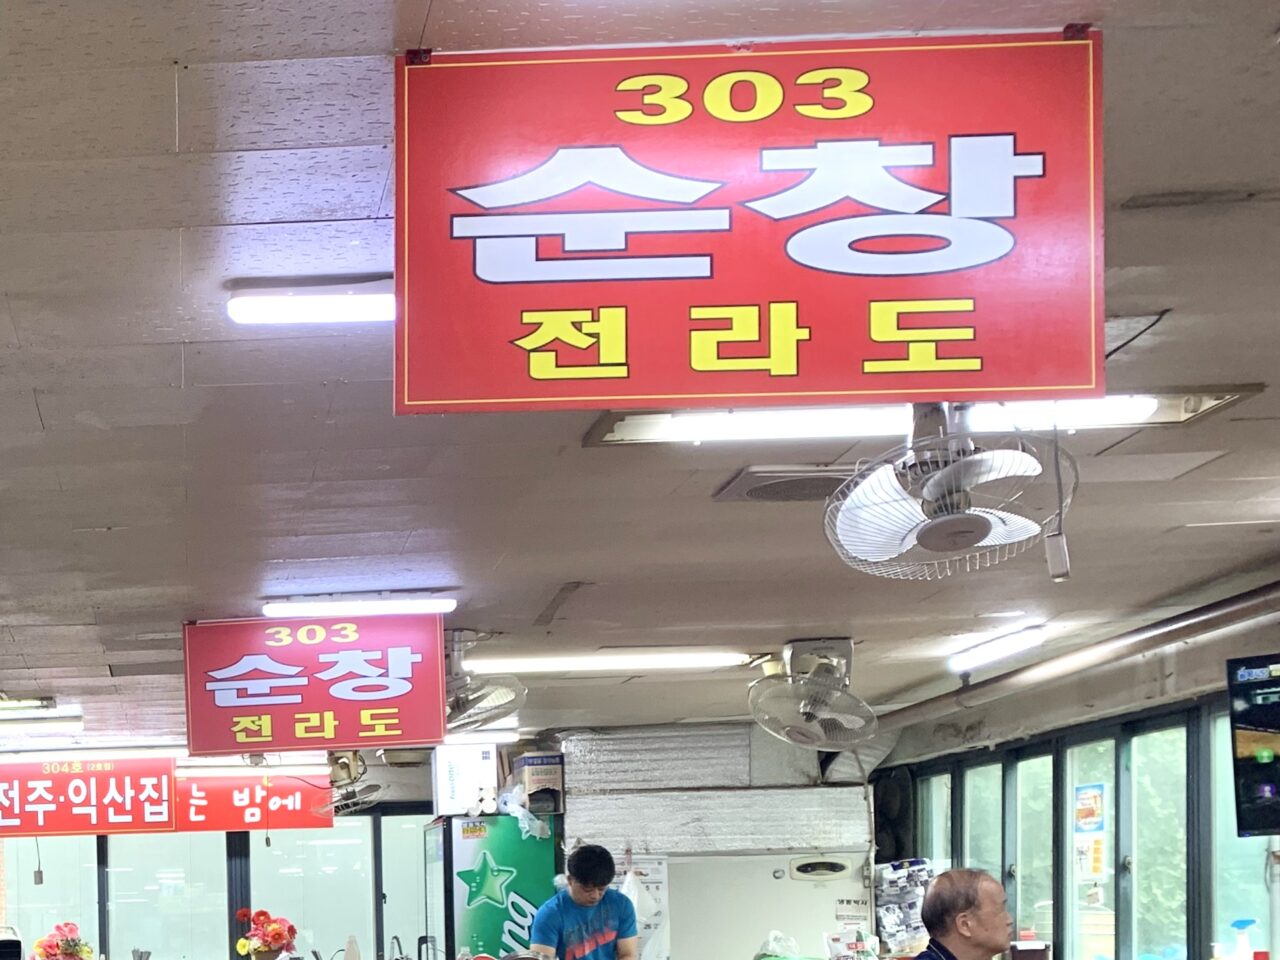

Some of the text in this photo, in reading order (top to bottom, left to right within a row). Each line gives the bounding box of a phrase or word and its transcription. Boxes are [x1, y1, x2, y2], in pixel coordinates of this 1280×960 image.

[614, 67, 875, 126] 303
[448, 132, 1045, 284] 순창
[512, 297, 983, 380] 전라도
[265, 622, 360, 647] 303
[206, 646, 422, 707] 순창
[231, 708, 403, 743] 전라도
[42, 760, 83, 774] 304호
[232, 785, 301, 823] 밤에
